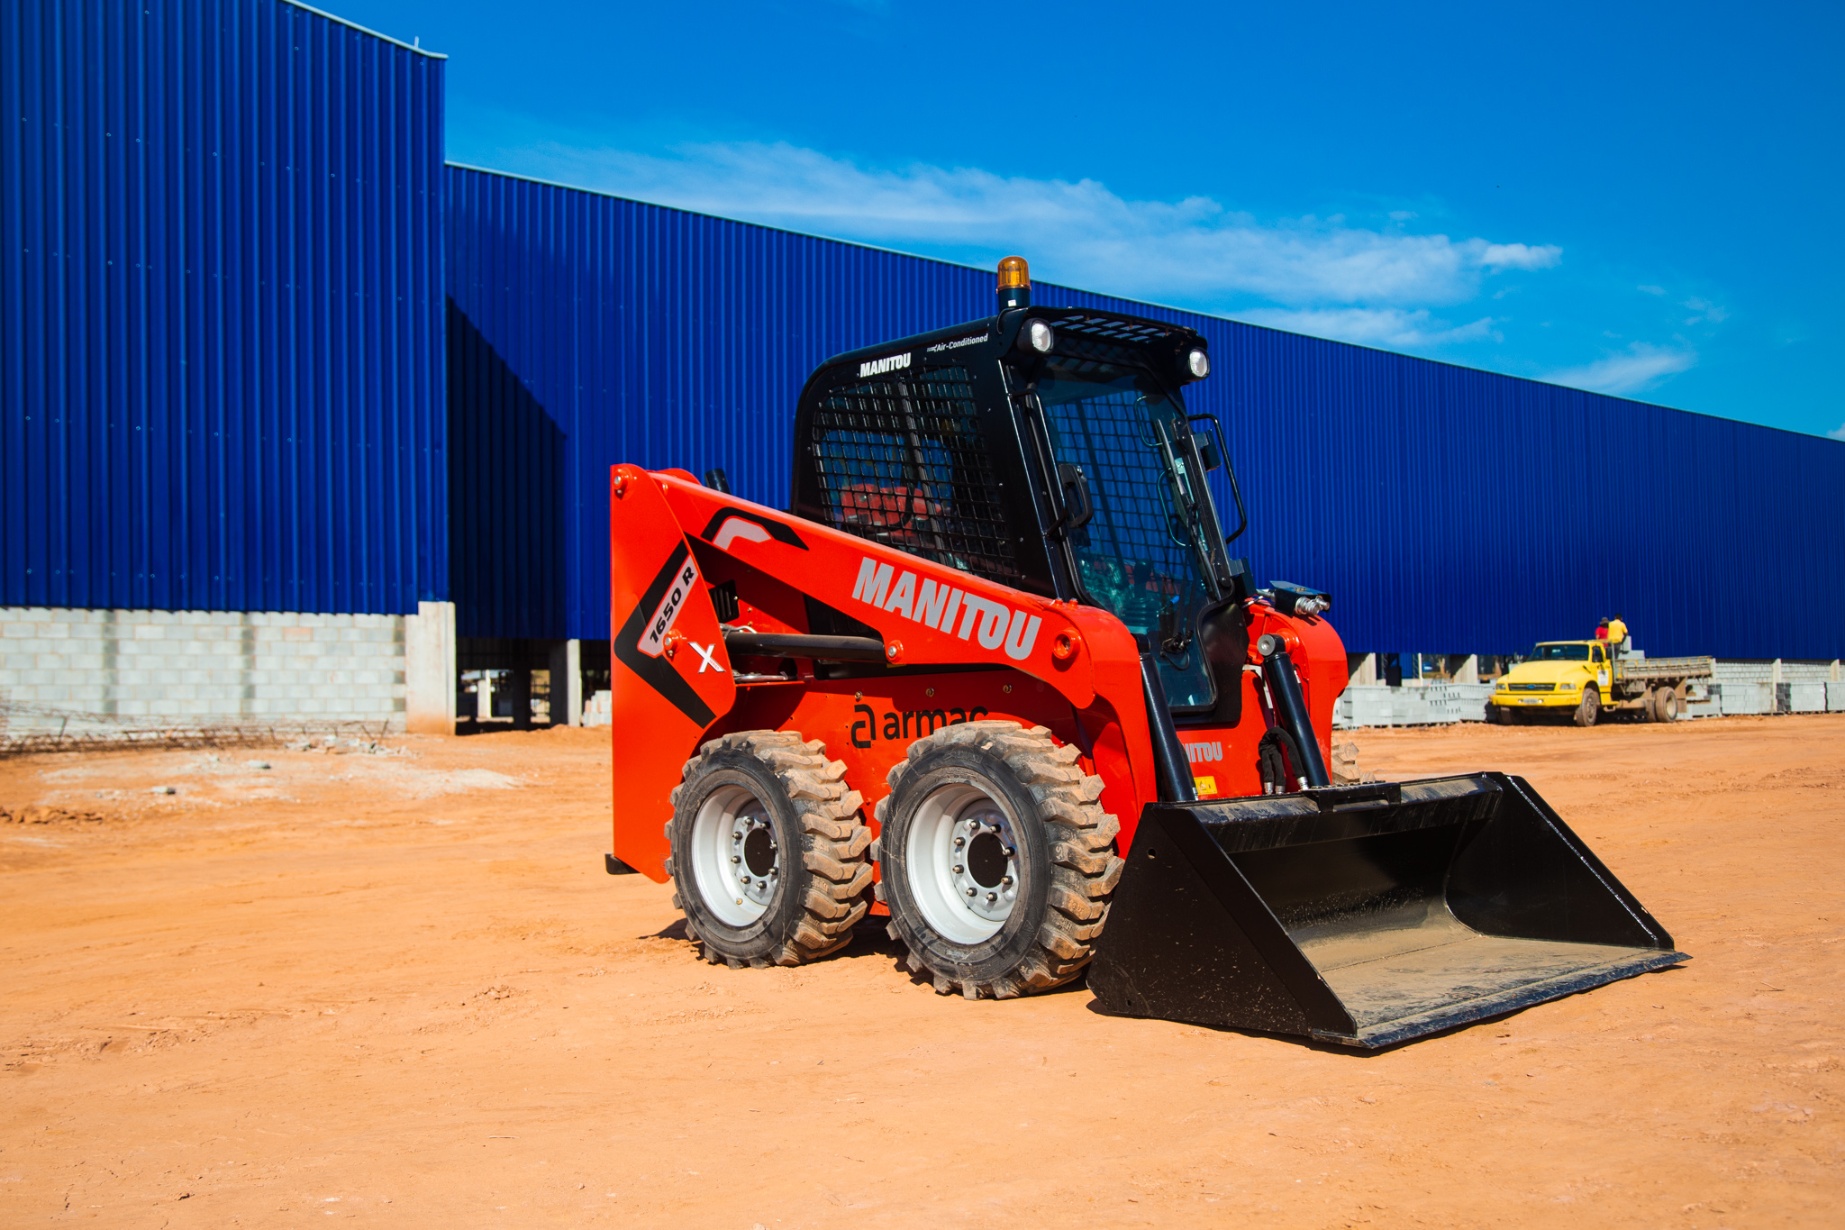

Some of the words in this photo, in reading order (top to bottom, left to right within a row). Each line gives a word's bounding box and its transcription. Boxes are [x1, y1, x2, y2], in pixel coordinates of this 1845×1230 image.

[860, 352, 912, 379] MANITOU
[936, 333, 989, 352] Air-Conditioned
[649, 587, 682, 643] 1650
[681, 566, 695, 586] R
[851, 556, 1043, 660] MANITOU
